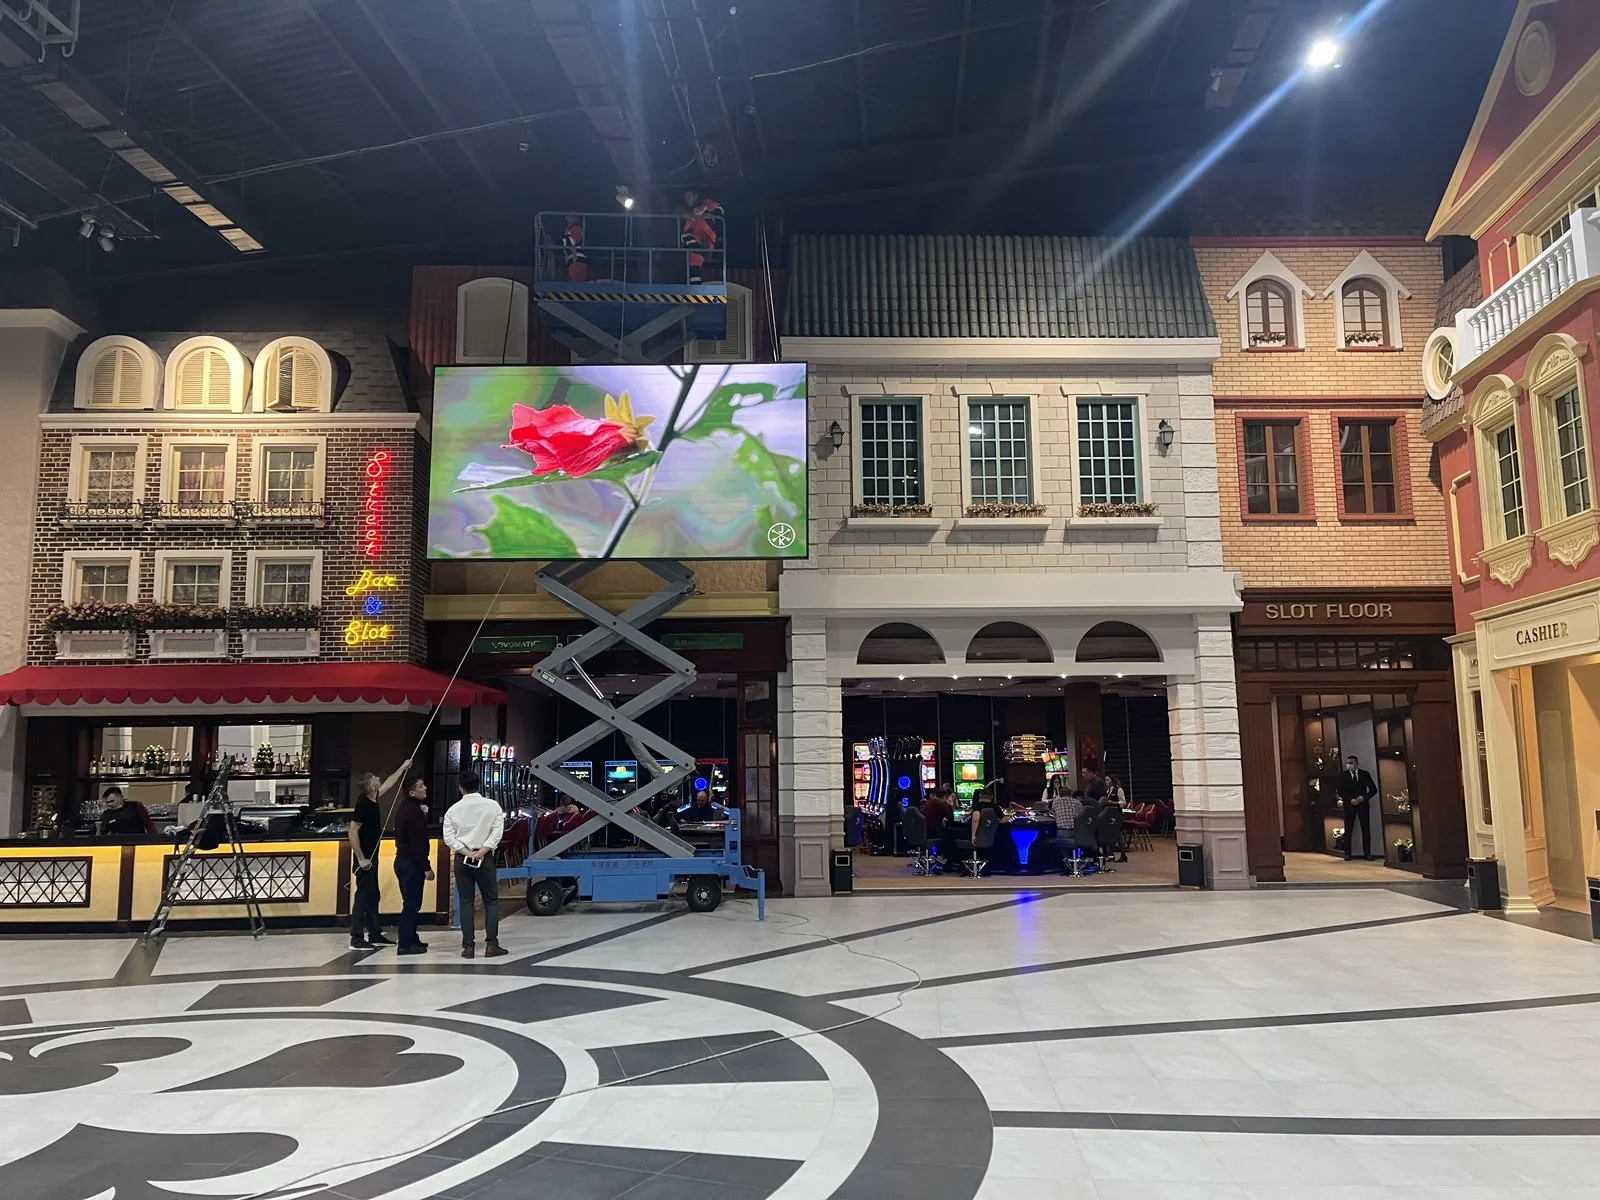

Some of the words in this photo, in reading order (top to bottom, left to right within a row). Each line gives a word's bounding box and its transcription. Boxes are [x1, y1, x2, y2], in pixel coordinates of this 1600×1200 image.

[366, 452, 388, 556] Street
[345, 569, 396, 596] Bar
[365, 596, 383, 614] &
[1265, 603, 1318, 619] SLOT
[1326, 603, 1393, 618] FLOOR
[344, 620, 389, 645] Slot
[1516, 622, 1569, 645] CASHIER
